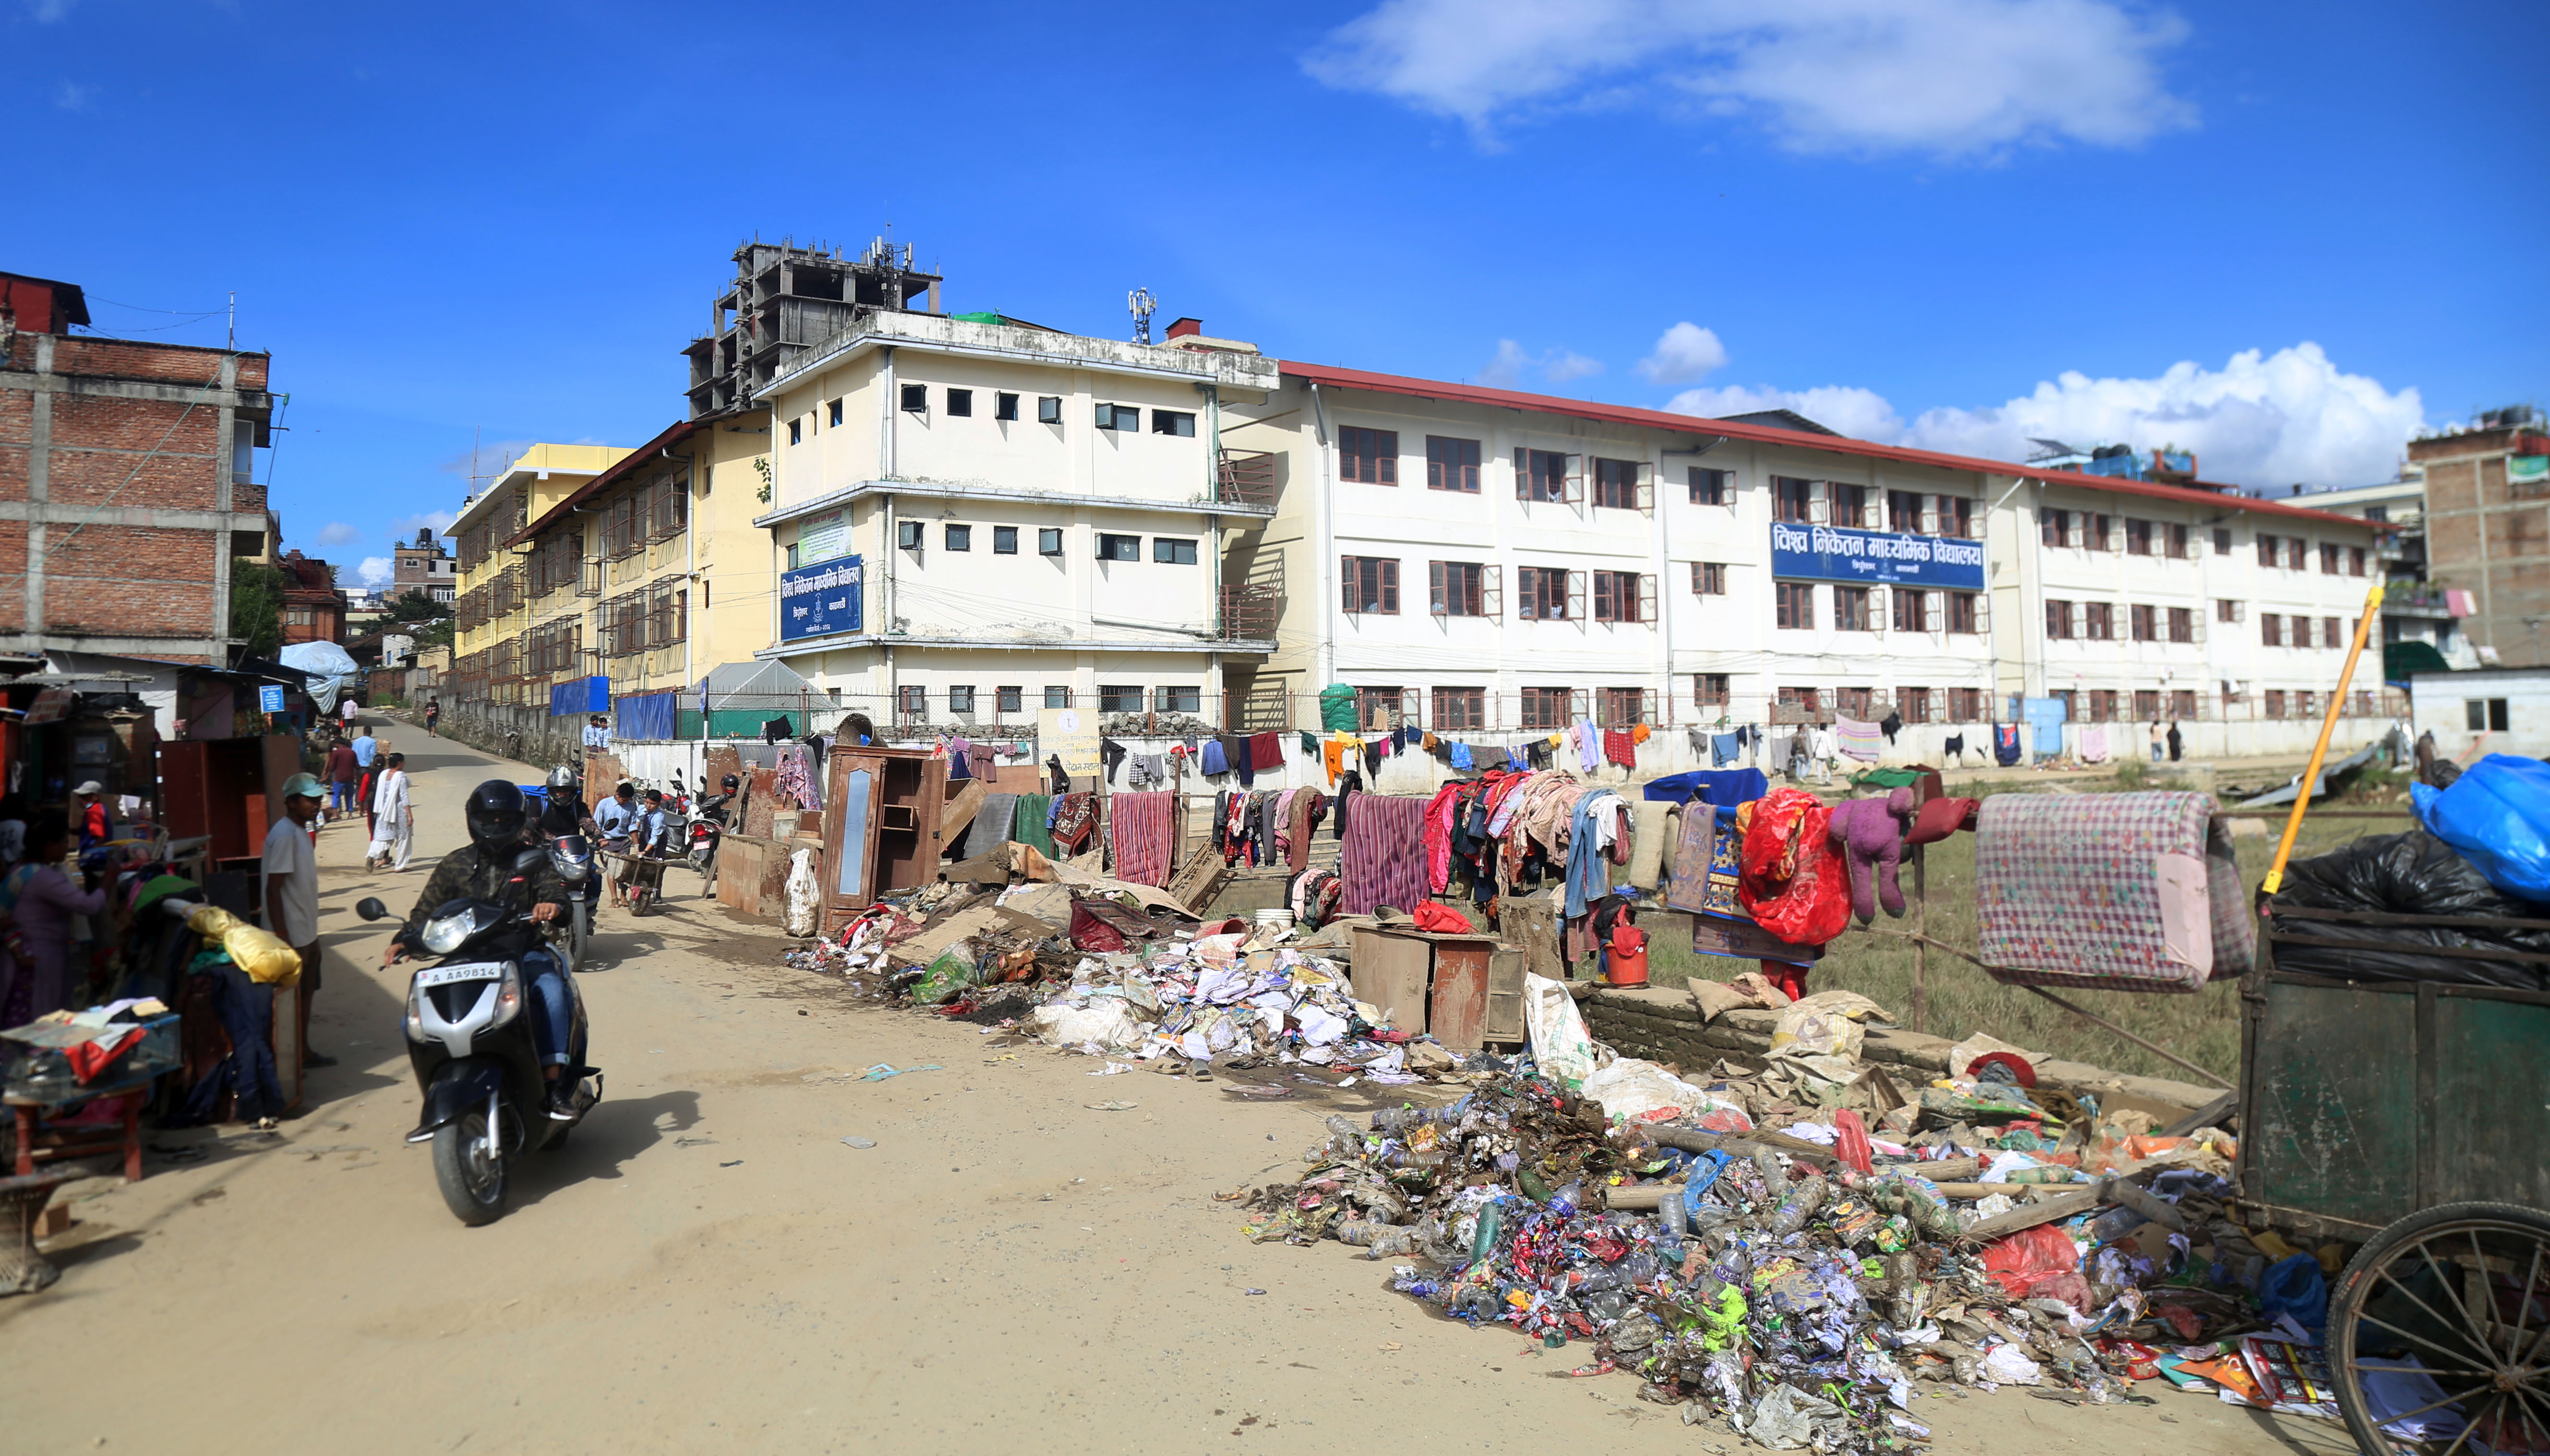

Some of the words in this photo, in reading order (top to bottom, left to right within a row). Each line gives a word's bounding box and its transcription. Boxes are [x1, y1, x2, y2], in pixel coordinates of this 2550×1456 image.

[1773, 525, 1808, 554] विश्व
[1812, 528, 1865, 557] निकेतन
[1867, 535, 1930, 561] माध्यमिक
[1932, 539, 1983, 566] विद्यालय
[782, 578, 794, 599] विश्व
[794, 575, 813, 596] निकेतन
[813, 568, 838, 591] माध्यमिक
[838, 565, 859, 586] विद्यालय
[433, 974, 440, 982] A
[447, 968, 494, 980] AA9814
